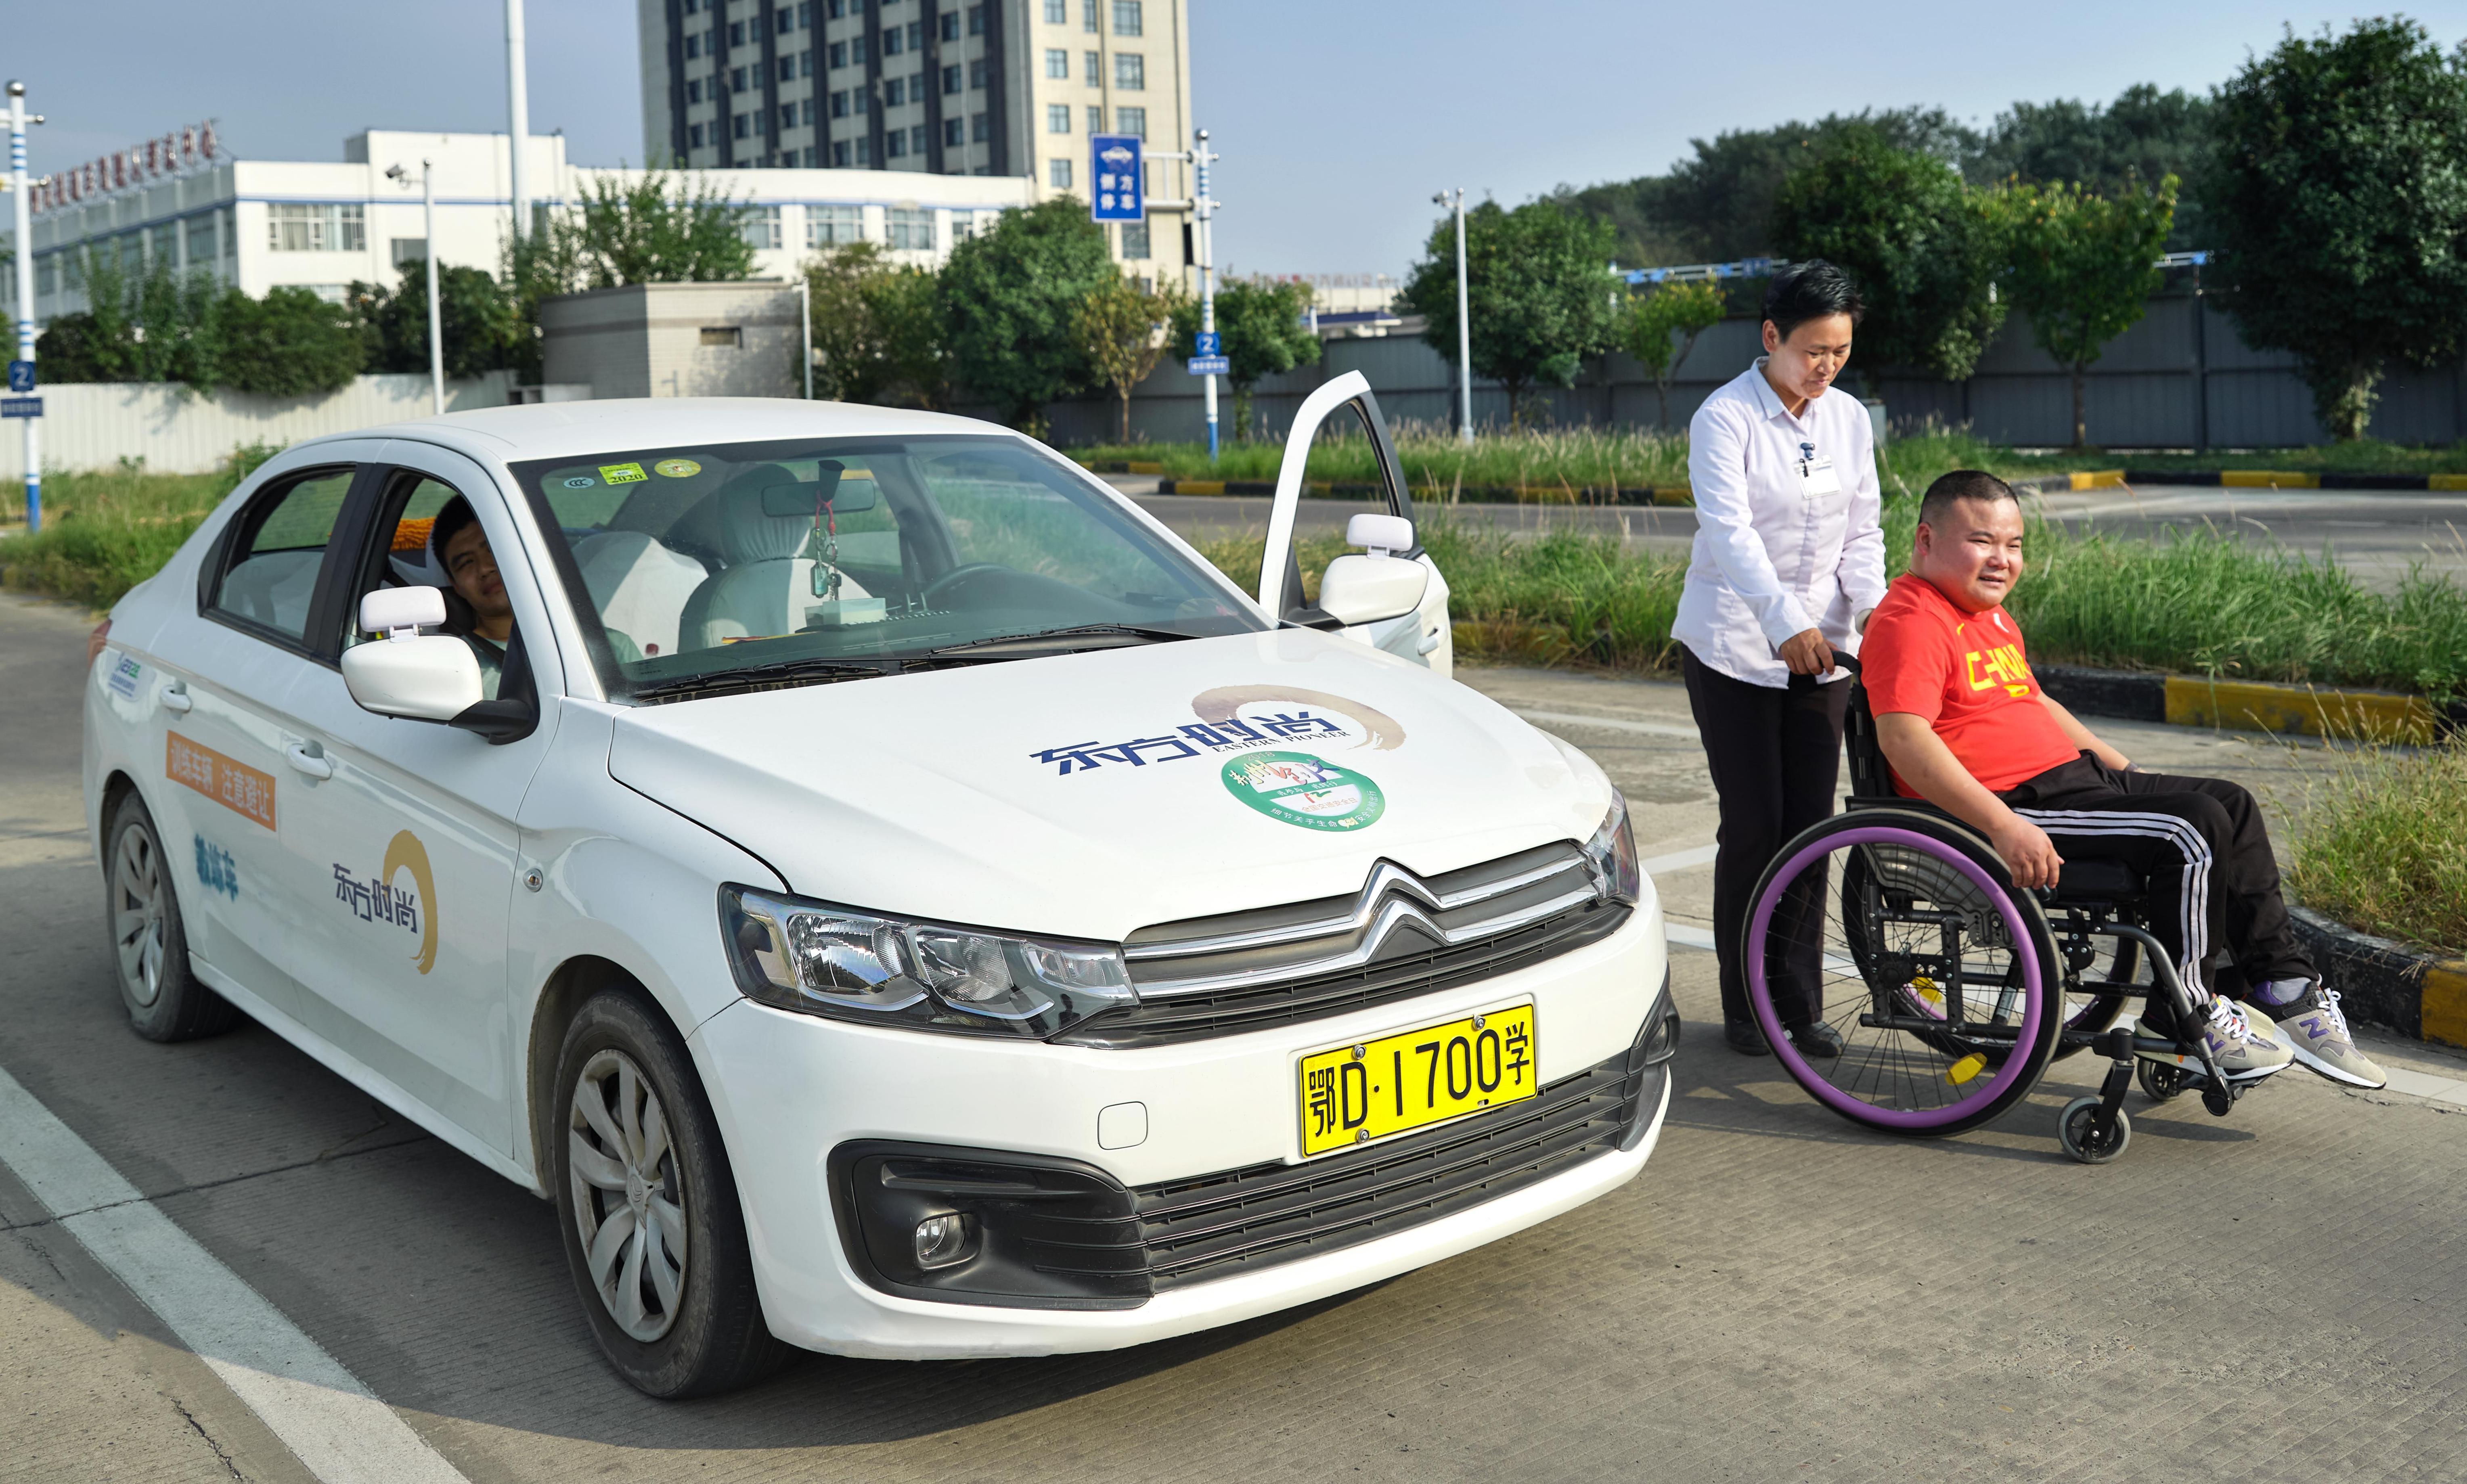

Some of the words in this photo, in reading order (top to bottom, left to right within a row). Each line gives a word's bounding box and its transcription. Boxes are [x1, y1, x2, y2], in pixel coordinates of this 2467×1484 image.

[1099, 193, 1136, 211] 停车
[1202, 335, 1215, 352] 2
[14, 365, 29, 387] 2
[609, 474, 643, 483] 2020
[1029, 711, 1342, 776] 东方时尚
[1212, 738, 1280, 752] EASTERN
[1286, 730, 1351, 742] PIONEER
[1243, 751, 1275, 761] 2018
[170, 739, 214, 793] 训练车辆
[221, 763, 270, 822] 注意避让
[1276, 787, 1304, 796] 我参与
[1311, 781, 1338, 789] 我践行
[1301, 797, 1358, 812] 全国交通安全日
[1270, 808, 1338, 828] 细节关乎生命
[333, 863, 418, 934] 东方时尚
[2299, 1016, 2330, 1040] N
[1309, 1021, 1530, 1137] 鄂D·1700学
